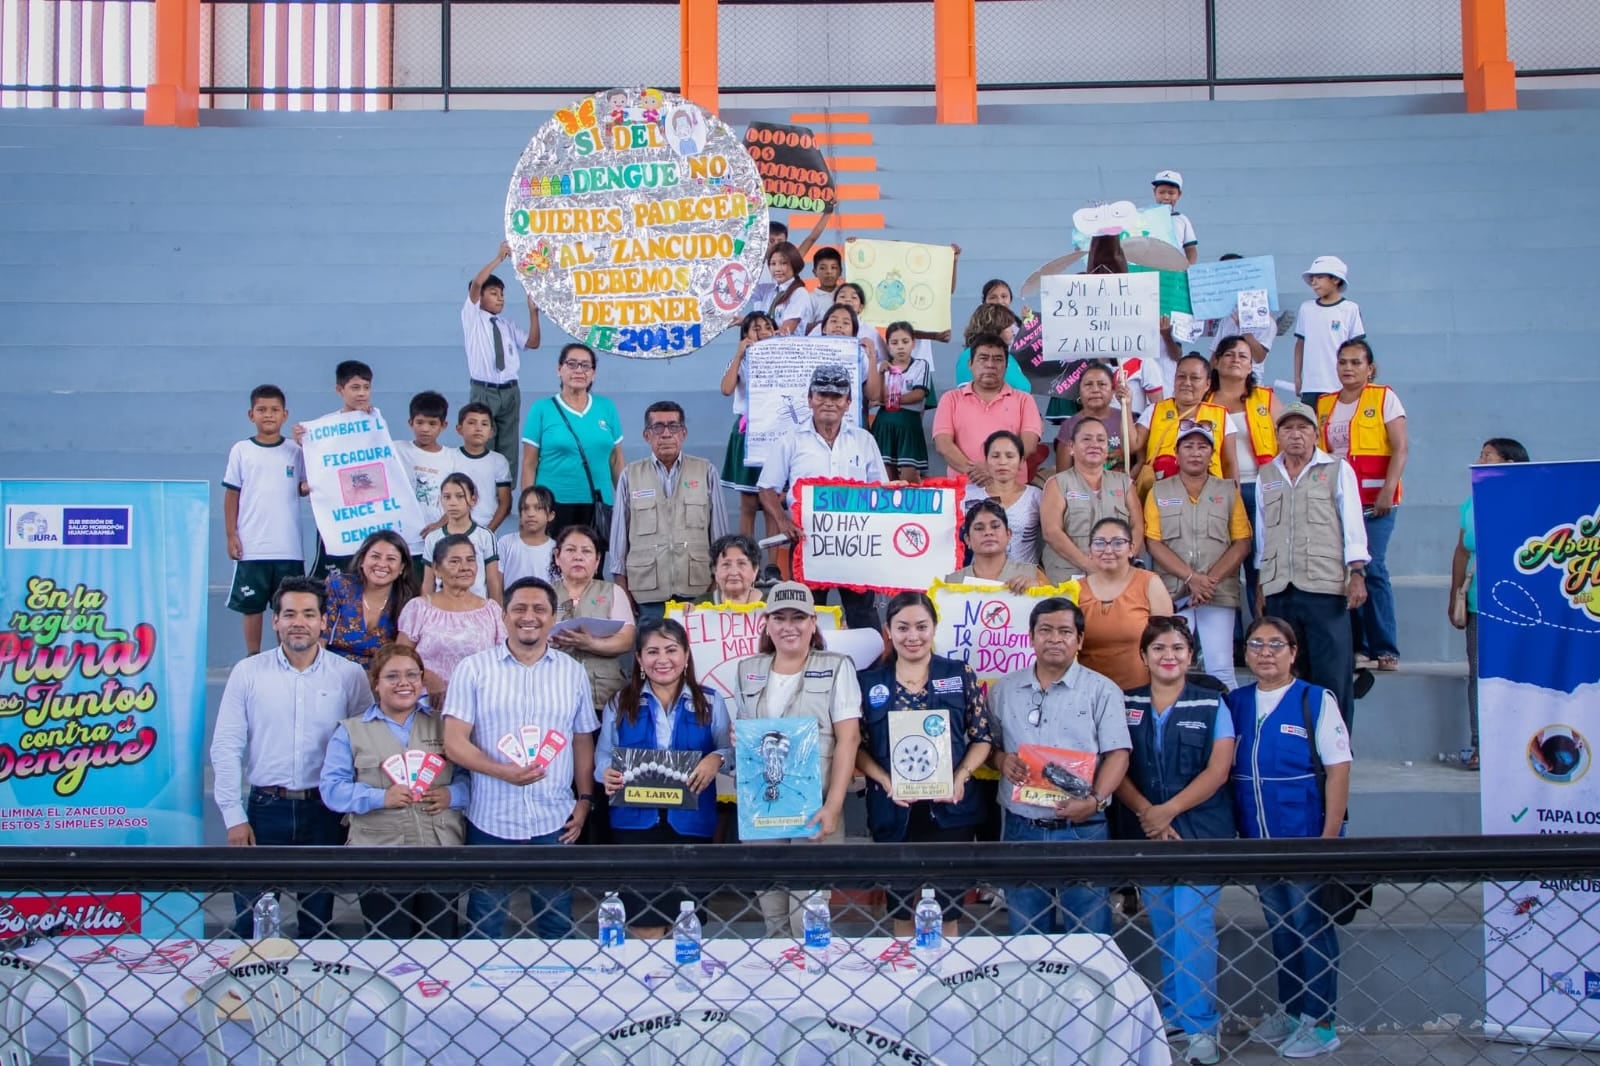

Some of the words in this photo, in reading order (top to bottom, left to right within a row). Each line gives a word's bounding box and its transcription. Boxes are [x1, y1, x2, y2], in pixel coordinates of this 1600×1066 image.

[575, 126, 603, 156] SI
[612, 123, 665, 151] DEL
[571, 163, 679, 194] DENGUE
[688, 156, 727, 179] NO
[511, 208, 622, 235] QUIERES
[633, 193, 748, 227] PADECER
[560, 241, 594, 268] AL
[611, 234, 733, 263] ZANCUDO
[573, 267, 690, 295] DEBEMOS
[580, 298, 701, 325] DETENER
[1052, 300, 1079, 317] 28
[1024, 317, 1038, 330] SIN
[1089, 320, 1110, 331] SIN
[618, 324, 701, 351] 20431
[1057, 335, 1146, 352] ZANCUDO
[1031, 354, 1043, 367] HA
[323, 446, 392, 466] PICADURA
[332, 501, 375, 521] VENCE
[383, 498, 400, 511] EL
[816, 490, 849, 509] SIN
[857, 490, 941, 513] MOSQUITO
[812, 514, 833, 532] NO
[837, 515, 870, 531] HAY
[811, 534, 882, 557] DENGUE
[27, 577, 70, 609] En
[74, 584, 107, 609] la
[10, 607, 127, 645] región
[685, 614, 716, 644] EL
[719, 612, 768, 641] DENG
[23, 676, 156, 727] Juntos
[20, 719, 112, 749] contra
[118, 716, 134, 732] el
[627, 790, 641, 798] LA
[646, 790, 680, 800] LARVA
[1, 808, 42, 818] LIMINA
[48, 808, 60, 817] EL
[66, 807, 126, 816] ZANCUDO
[1, 820, 40, 830] ESTOS
[44, 820, 50, 829] 3
[54, 819, 104, 828] SIMPLES
[108, 818, 148, 827] PASOS
[1536, 809, 1574, 823] TAPA
[229, 961, 289, 979] VECTORES
[1036, 961, 1069, 975] 2025
[608, 1014, 682, 1040] VECTORES
